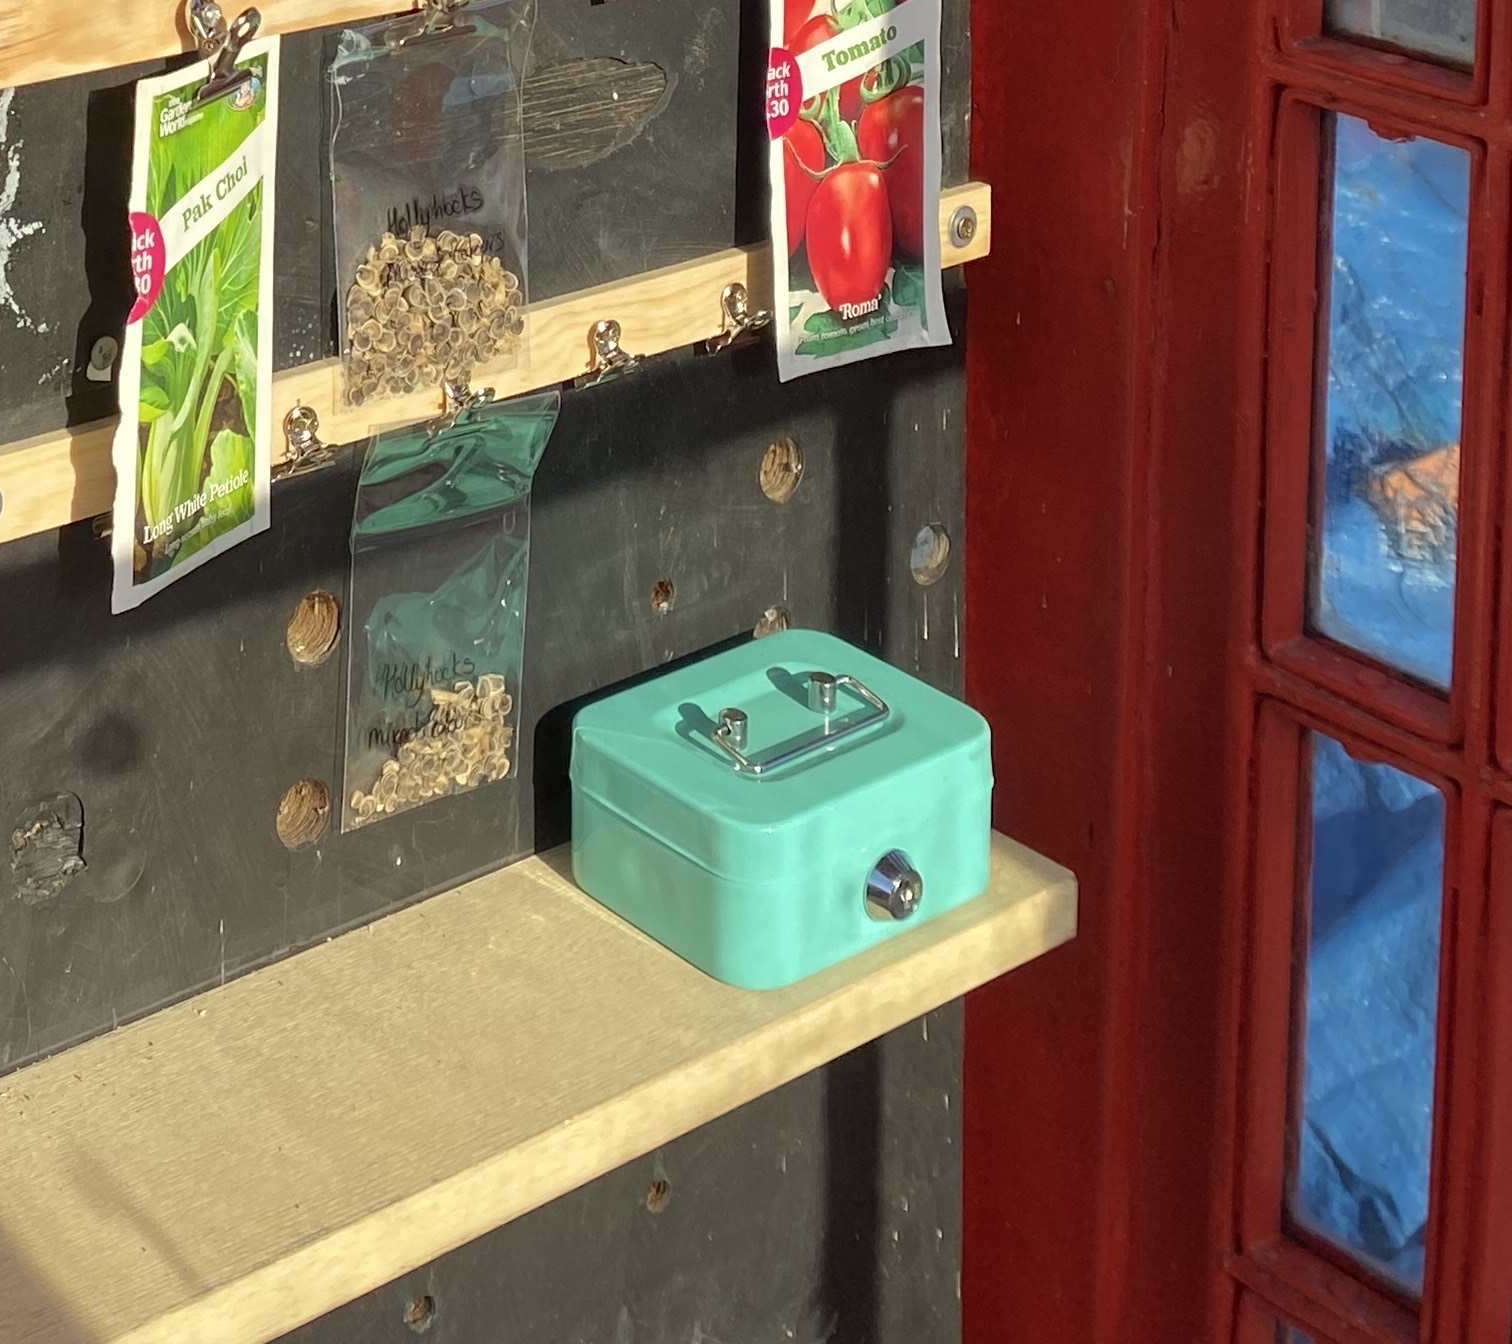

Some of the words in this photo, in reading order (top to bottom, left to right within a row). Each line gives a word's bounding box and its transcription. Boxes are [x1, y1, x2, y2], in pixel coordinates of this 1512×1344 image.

[822, 25, 897, 72] Tomato
[182, 193, 213, 233] Pak
[215, 156, 248, 203] Choi
[143, 512, 173, 545] Long
[174, 493, 207, 524] White
[209, 469, 249, 503] Petiole
